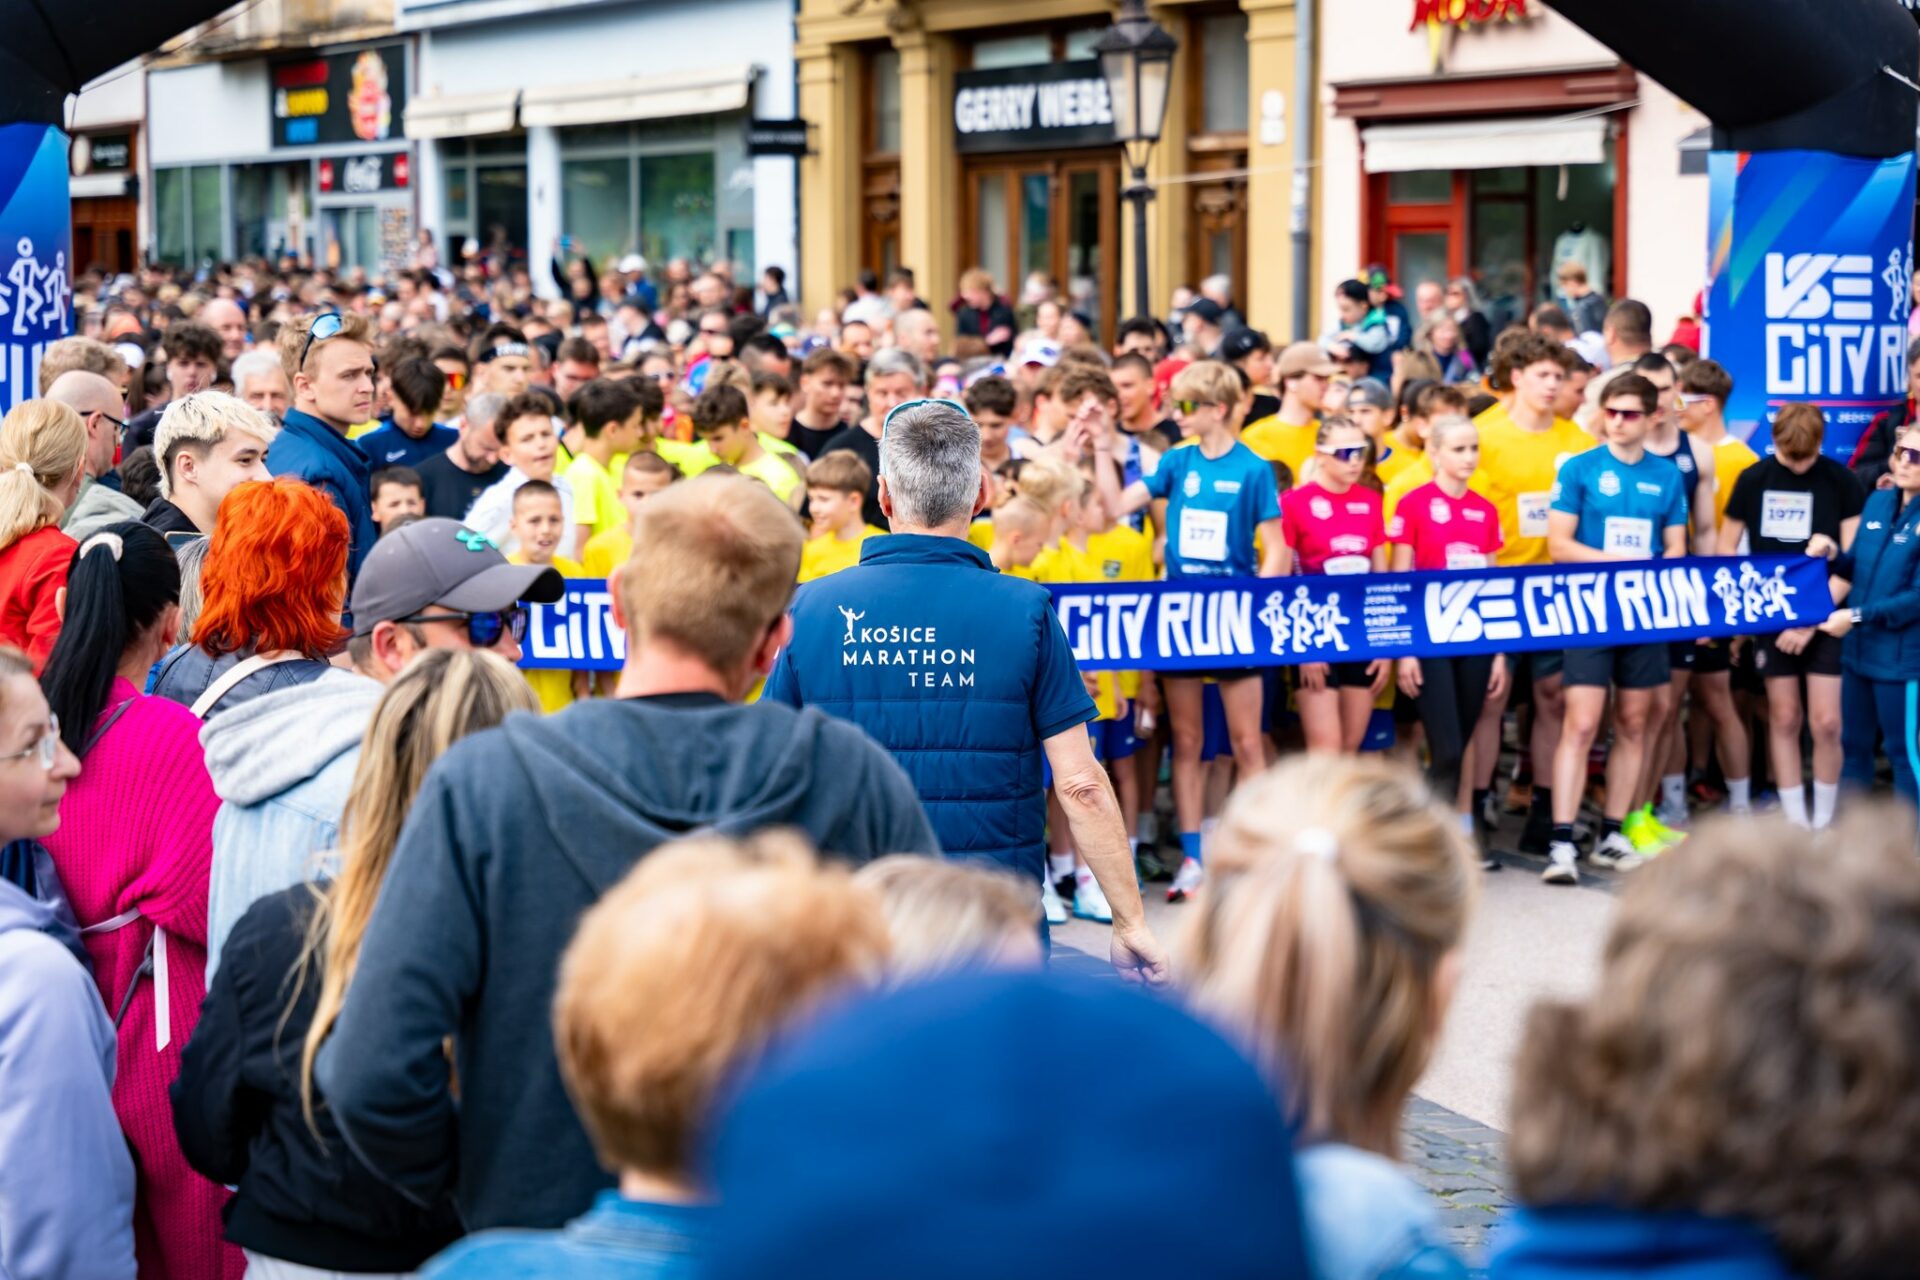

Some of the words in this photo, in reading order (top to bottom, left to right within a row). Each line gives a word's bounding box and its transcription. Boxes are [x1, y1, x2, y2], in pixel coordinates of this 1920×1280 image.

[955, 83, 1037, 133] GERRY
[1038, 78, 1114, 129] WEBE
[1768, 508, 1806, 521] 1977
[1190, 527, 1215, 541] 177
[1615, 534, 1642, 547] 181
[1614, 566, 1711, 632] RUN
[1157, 590, 1255, 658] RUN
[861, 626, 936, 643] KOŠICE
[843, 649, 975, 666] MARATHON
[908, 672, 975, 687] TEAM
